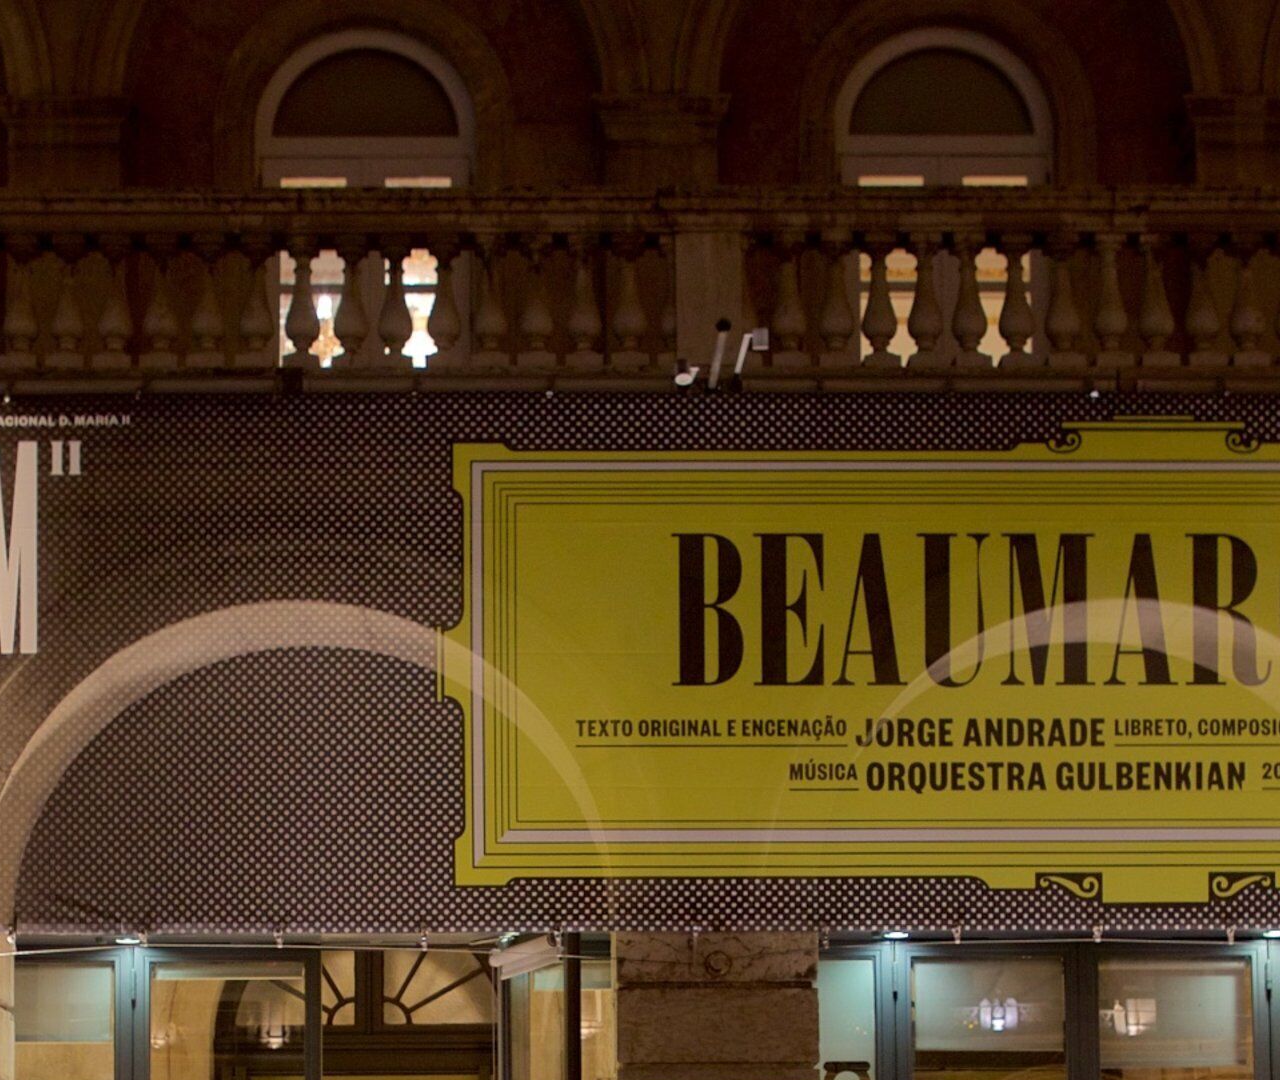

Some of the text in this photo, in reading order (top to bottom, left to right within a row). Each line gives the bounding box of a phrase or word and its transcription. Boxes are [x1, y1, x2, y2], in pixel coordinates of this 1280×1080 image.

[58, 415, 71, 427] D.
[50, 440, 82, 476] II
[575, 718, 633, 738] TEXTO
[638, 718, 722, 738] ORIGINAL
[726, 719, 737, 738] E
[741, 715, 848, 741] ENCENAÇÃO
[855, 717, 954, 748] JORGE
[962, 717, 1106, 748] ANDRADE
[1114, 717, 1193, 739] LIBRETO,
[788, 758, 859, 782] MÚSICA
[865, 761, 1048, 794] ORQUESTRA
[1055, 761, 1246, 791] GULBENKIAN
